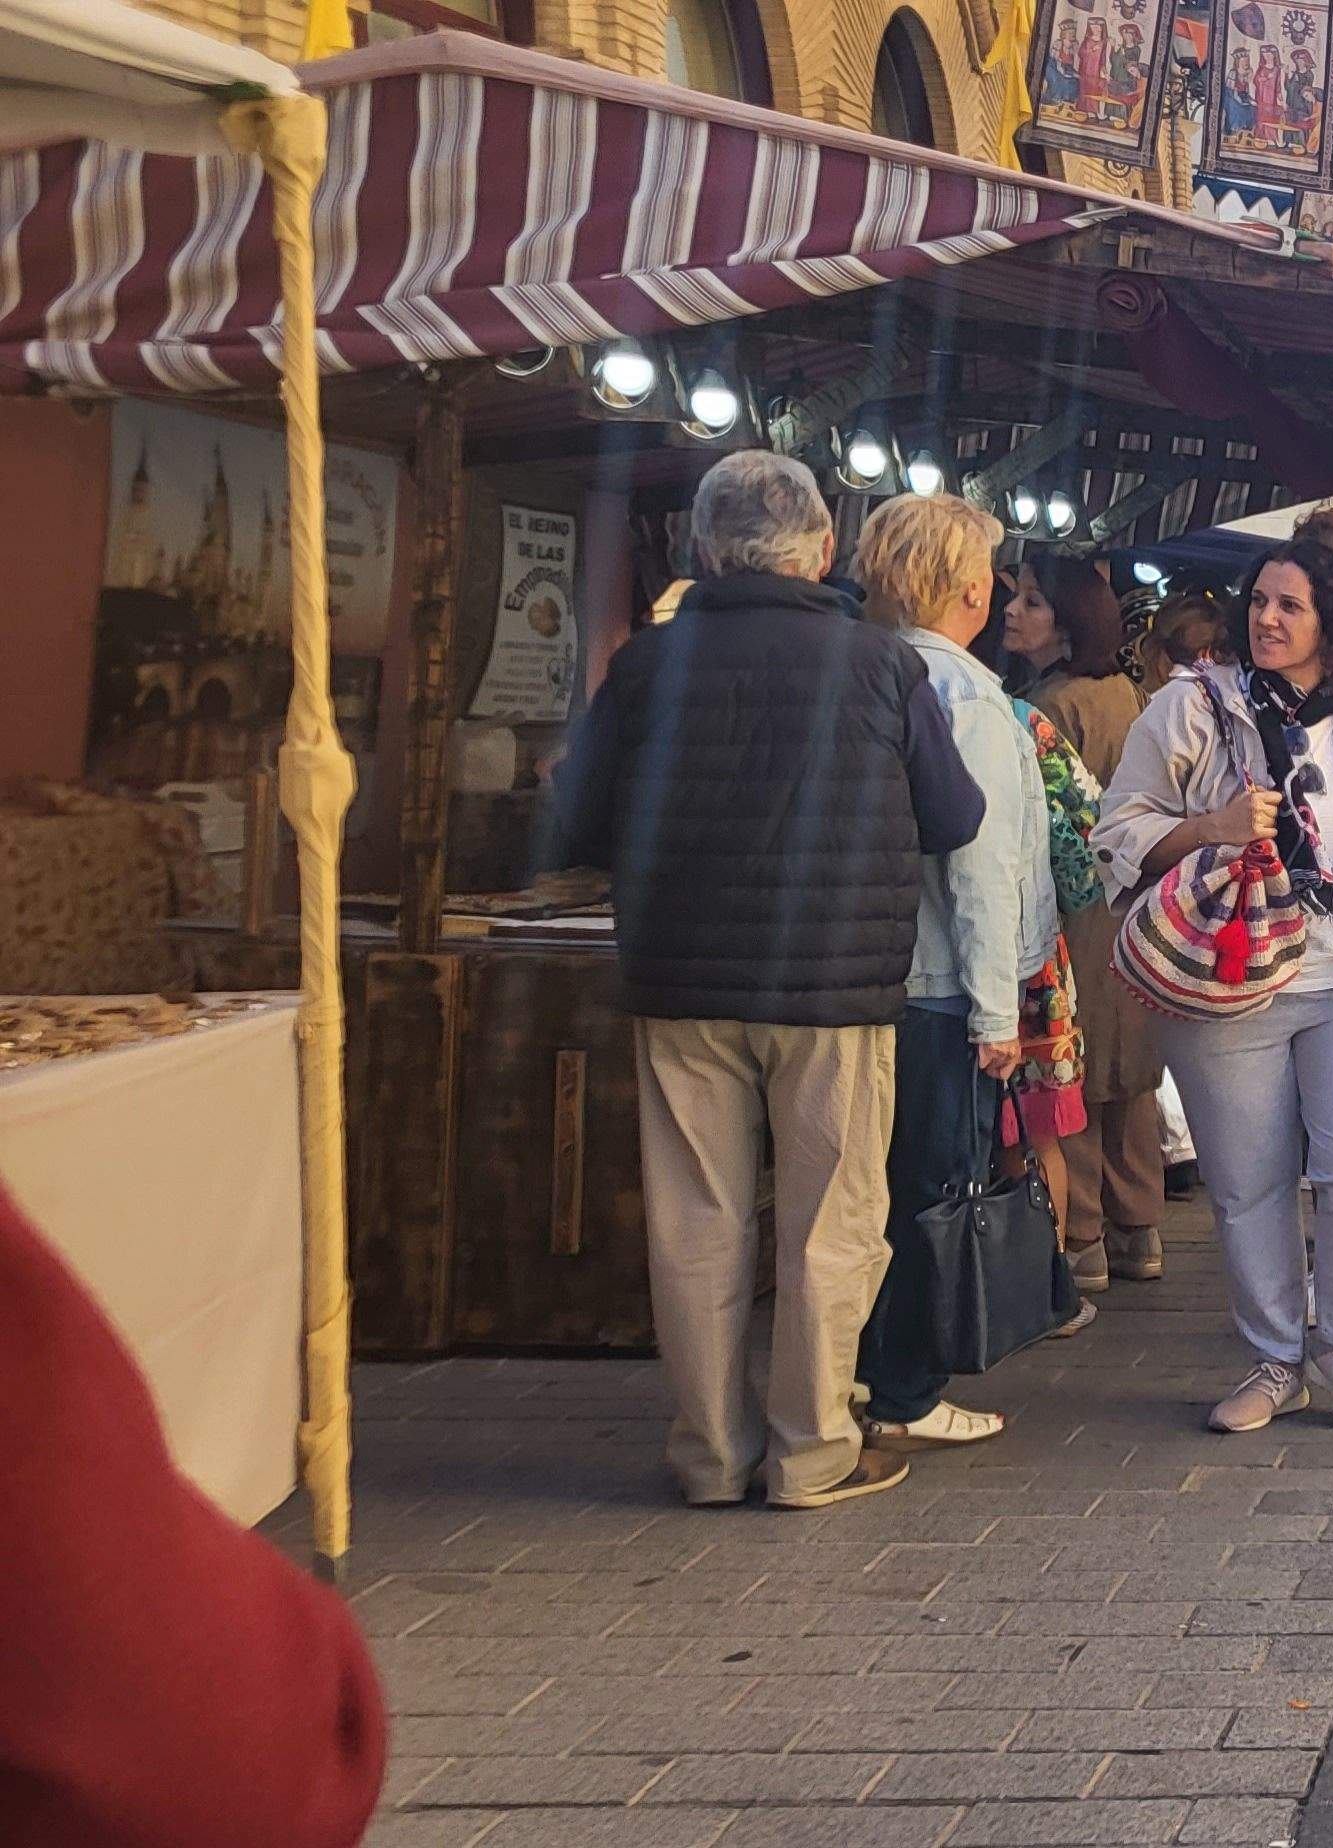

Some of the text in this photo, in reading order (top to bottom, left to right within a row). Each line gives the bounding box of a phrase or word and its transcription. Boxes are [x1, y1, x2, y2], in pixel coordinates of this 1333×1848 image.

[508, 513, 522, 530] EL
[518, 541, 565, 562] DE LAS
